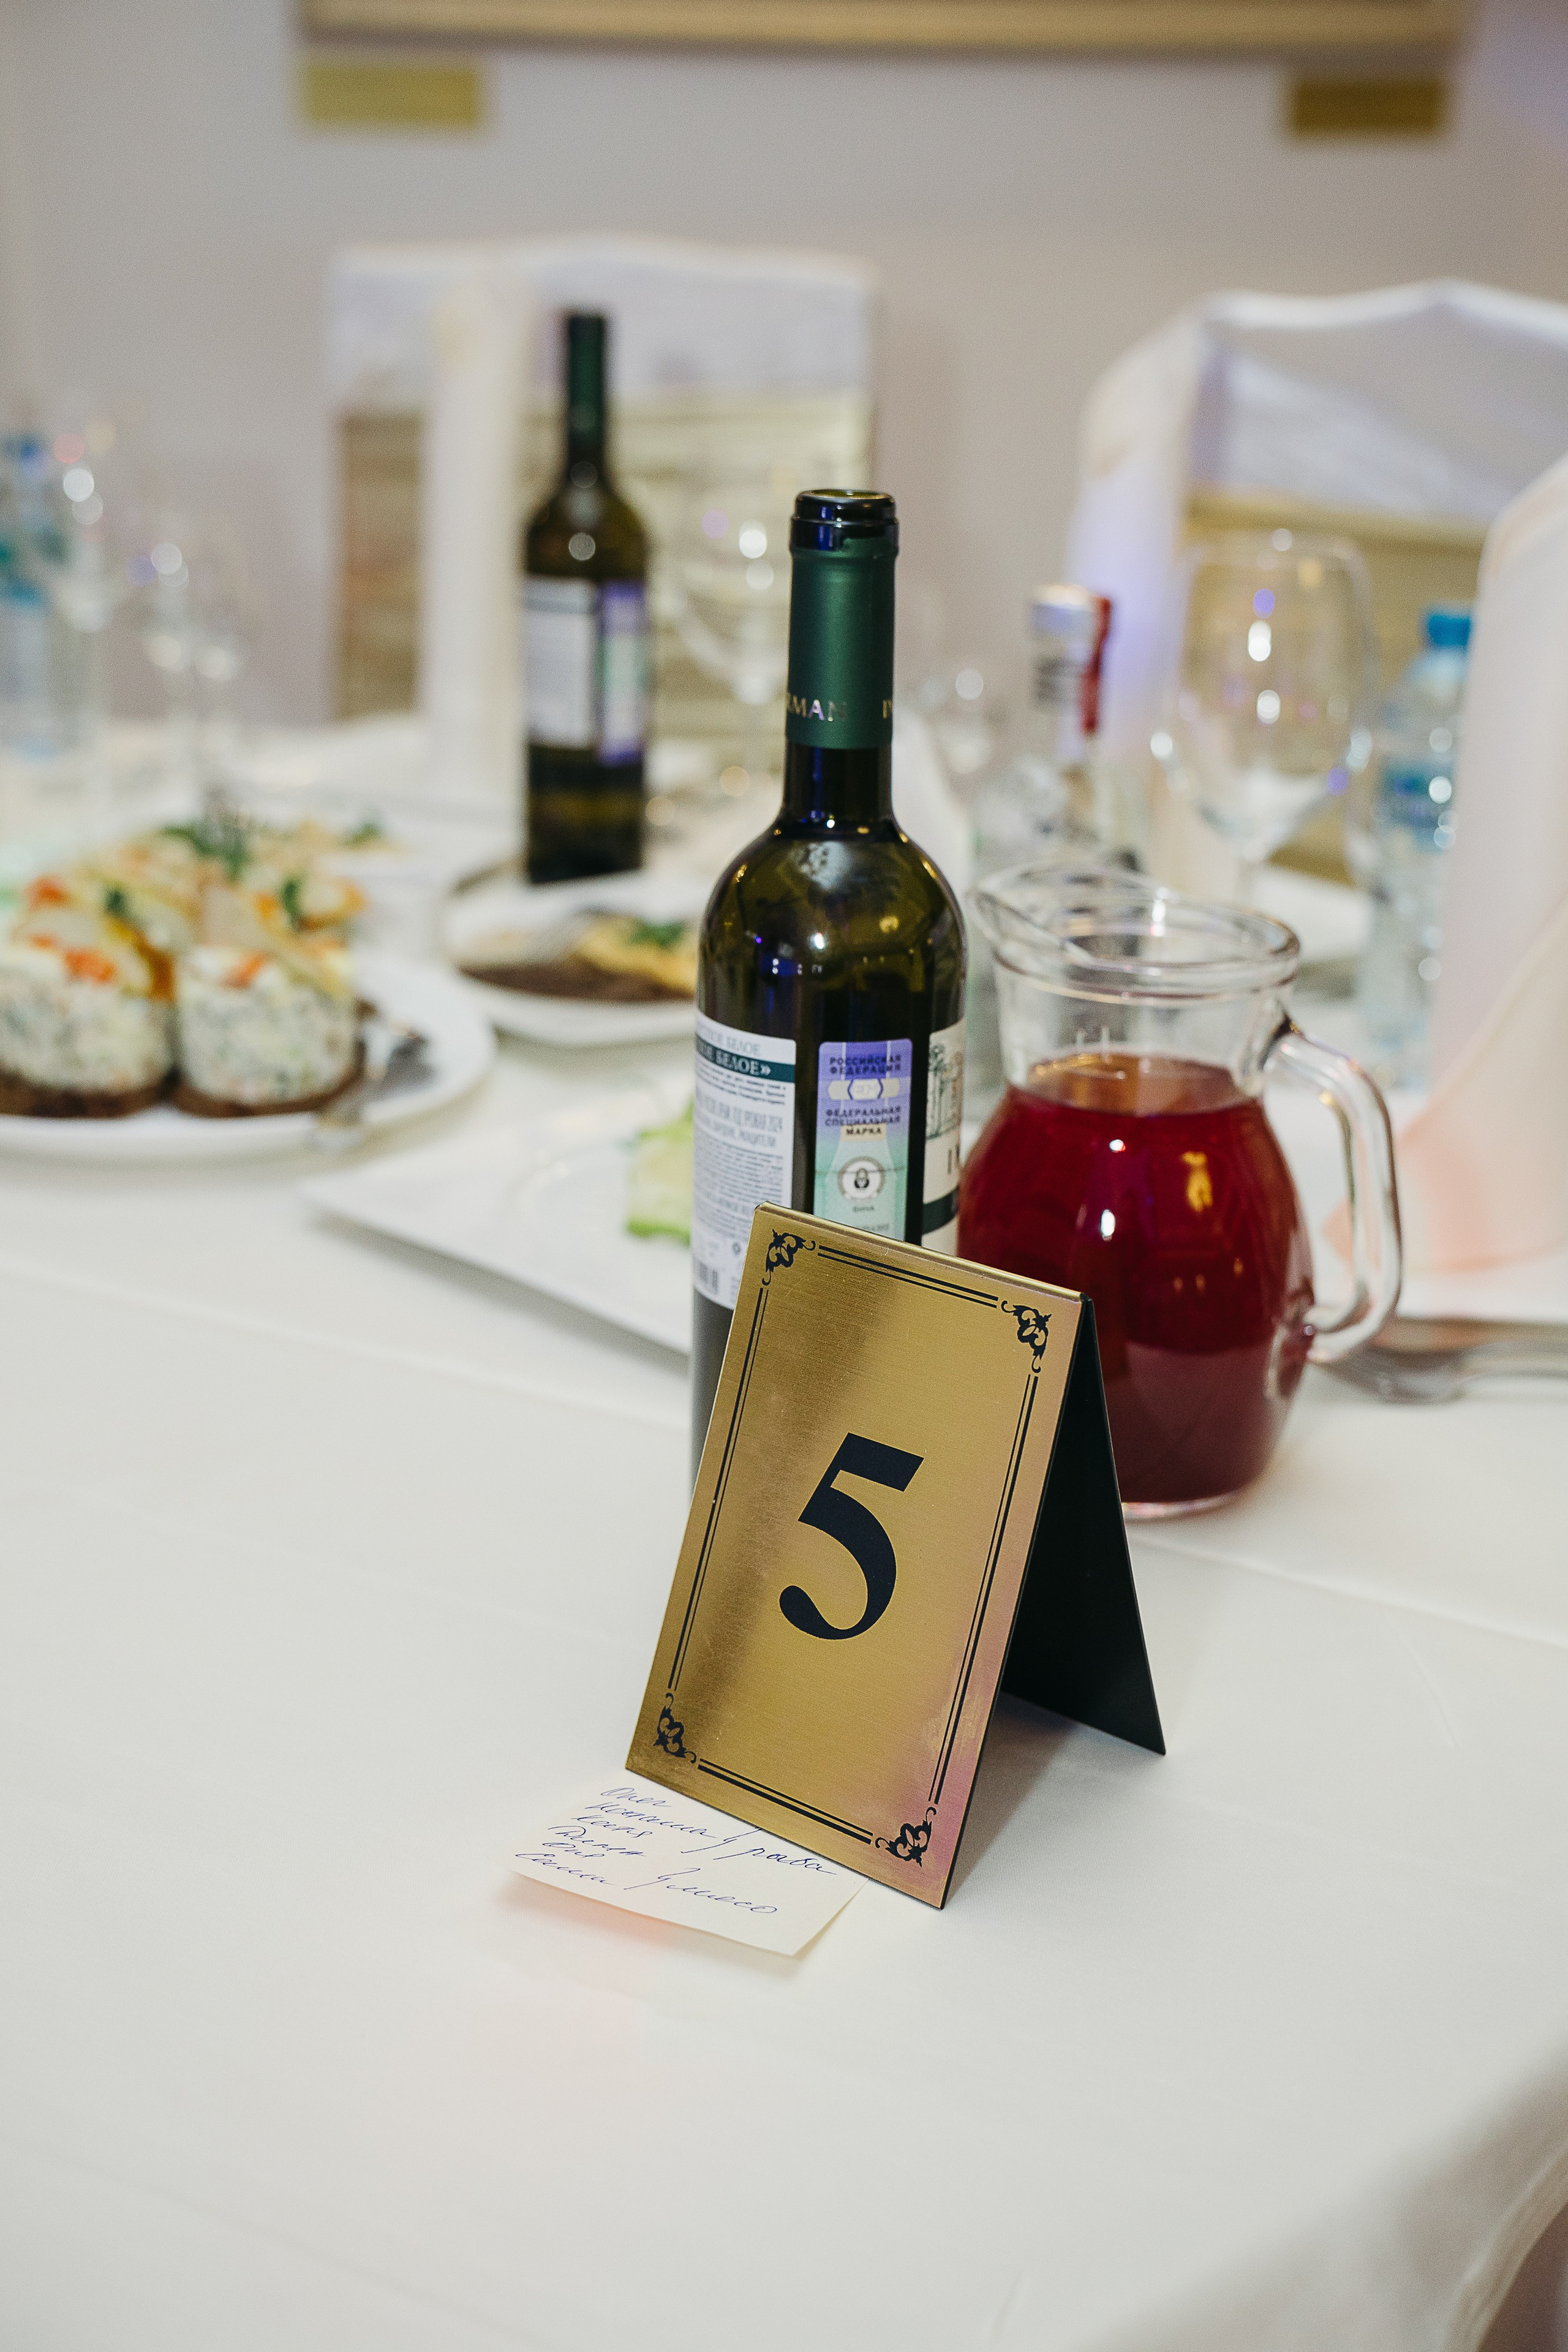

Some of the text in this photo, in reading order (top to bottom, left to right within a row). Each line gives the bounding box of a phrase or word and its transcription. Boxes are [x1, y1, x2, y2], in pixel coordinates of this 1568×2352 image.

[829, 1054, 902, 1065] РОССИЙСКАЯ
[829, 1063, 901, 1076] ФЕДЕРАЦИЯ
[826, 1106, 901, 1117] ФЕДЕРАЛЬНАЯ
[825, 1115, 901, 1127] СПЕЦИАЛЬНАЯ
[846, 1127, 881, 1136] МАРКА
[779, 1432, 924, 1640] 5
